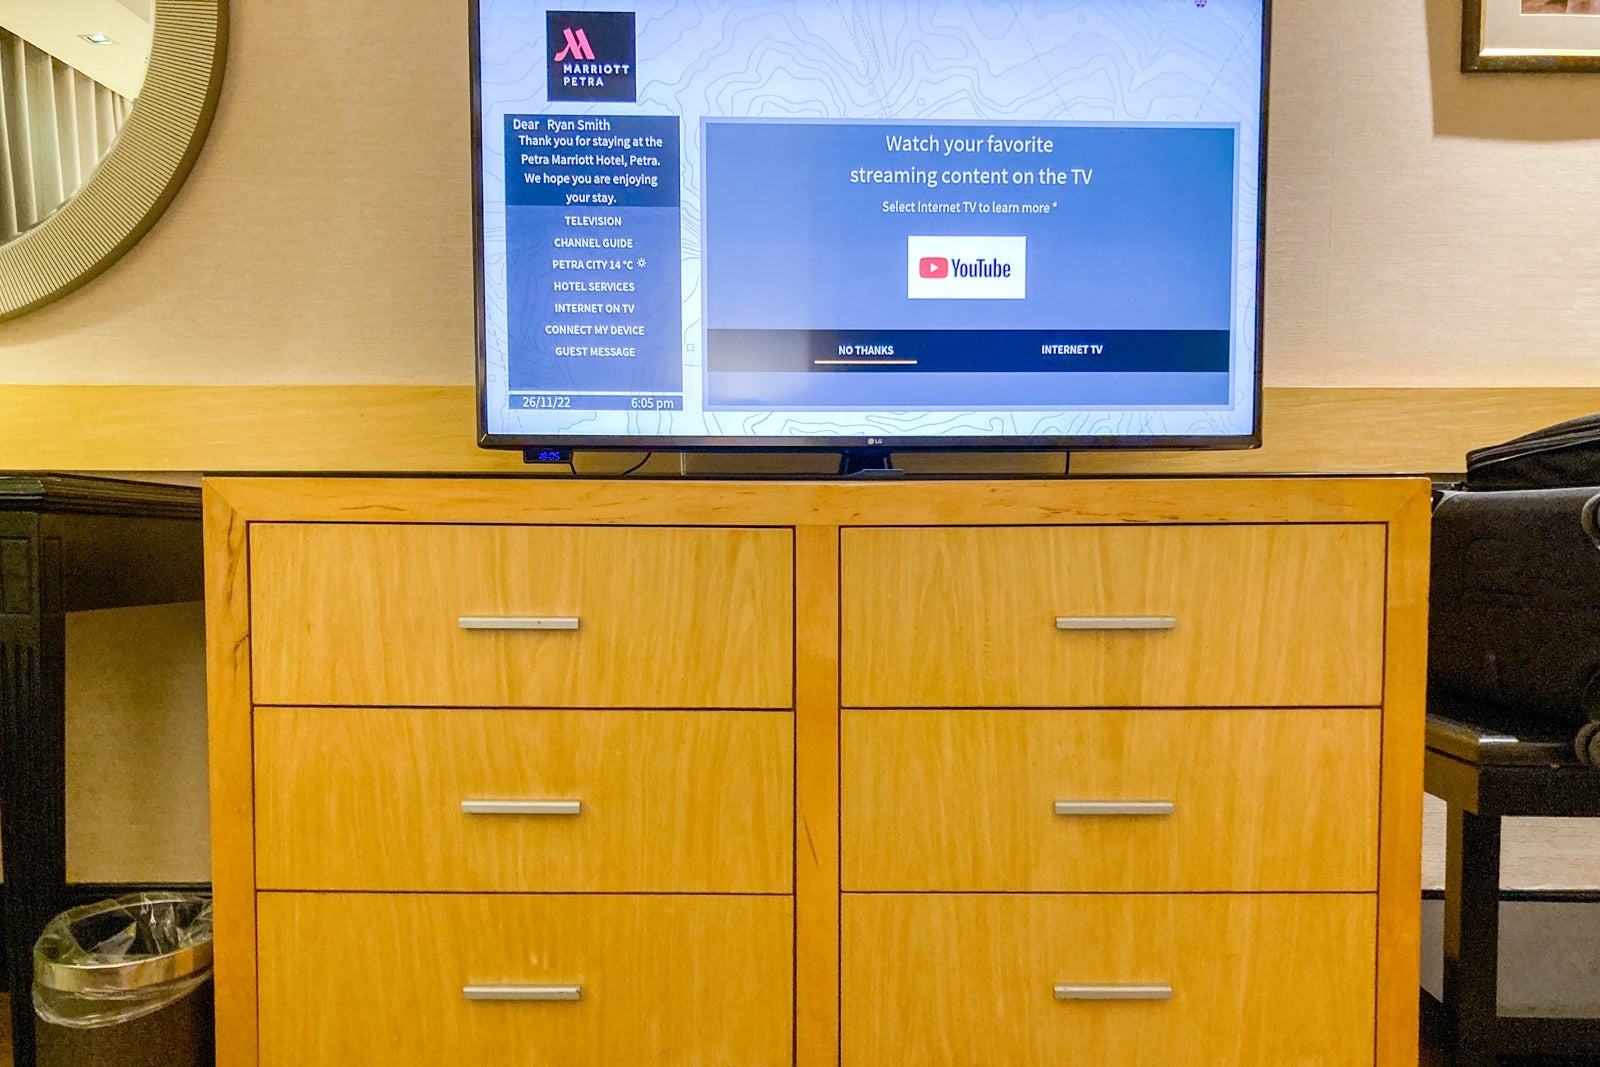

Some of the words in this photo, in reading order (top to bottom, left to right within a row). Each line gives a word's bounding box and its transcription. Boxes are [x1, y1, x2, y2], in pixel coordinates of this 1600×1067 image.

[563, 64, 629, 74] MARRIOTT
[563, 77, 604, 86] PETRA
[513, 119, 540, 130] Dear
[547, 120, 575, 133] Ryan
[577, 119, 610, 130] Smith
[519, 135, 551, 146] Thank
[554, 138, 573, 148] you
[575, 135, 590, 146] for
[593, 136, 630, 149] staying
[633, 137, 643, 146] at
[645, 136, 663, 147] the
[886, 135, 940, 151] Watch
[944, 139, 984, 155] your
[987, 135, 1053, 152] favorite
[521, 154, 549, 165] Petra
[551, 155, 594, 165] Marriott
[596, 155, 628, 167] Hotel,
[630, 156, 660, 166] Petra.
[524, 173, 541, 183] We
[543, 173, 570, 186] hope
[572, 175, 591, 186] you
[594, 175, 610, 184] are
[613, 174, 658, 187] enjoying
[850, 167, 938, 187] streaming
[941, 168, 1008, 184] content
[1012, 172, 1034, 184] on
[1038, 168, 1067, 185] the
[1071, 169, 1093, 185] TV
[566, 194, 589, 205] your
[592, 193, 616, 205] stay.
[882, 201, 915, 212] Select
[918, 202, 961, 212] Internet
[963, 202, 977, 213] TV
[978, 204, 990, 213] to
[992, 203, 1020, 213] learn
[565, 216, 621, 226] TELEVISION
[554, 238, 600, 248] CHANNEL
[603, 238, 633, 248] GUIDE
[552, 260, 584, 269] PETRA
[586, 260, 608, 269] CITY
[609, 261, 621, 269] 14
[951, 258, 1011, 278] YouTube
[554, 282, 587, 291] HOTEL
[589, 282, 635, 291] SERVICES
[555, 304, 603, 313] INTERNET
[606, 304, 620, 313] ON
[622, 304, 634, 313] TV
[545, 325, 592, 335] CONNECT
[595, 326, 609, 335] MY
[610, 326, 645, 335] DEVICE
[555, 347, 588, 356] GUEST
[590, 347, 635, 357] MESSAGE
[839, 346, 853, 355] NO
[855, 346, 894, 355] THANKS
[1041, 345, 1088, 354] INTERNET
[1090, 345, 1103, 354] TV
[522, 397, 571, 408] 26/11/22
[631, 398, 653, 408] 6:05
[656, 400, 674, 411] pm
